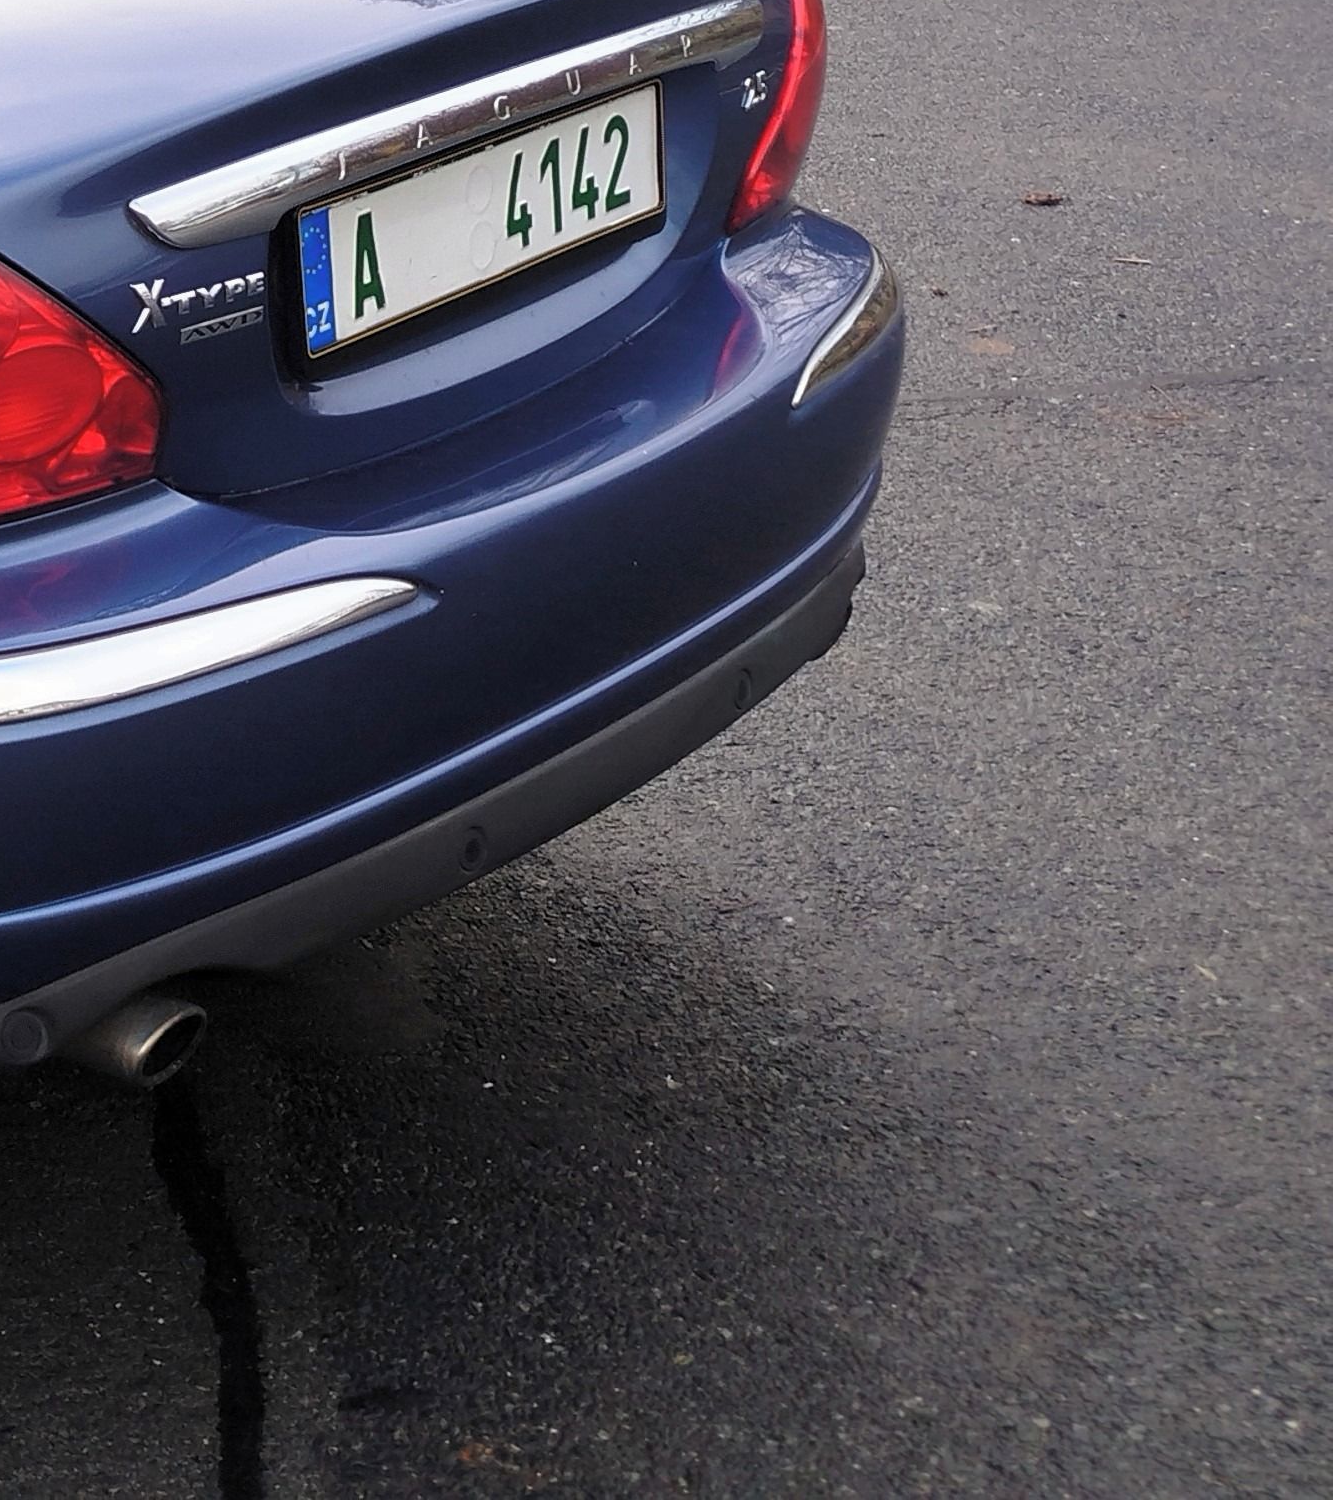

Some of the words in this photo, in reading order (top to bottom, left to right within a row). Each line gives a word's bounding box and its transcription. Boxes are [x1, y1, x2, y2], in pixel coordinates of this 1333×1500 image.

[337, 34, 694, 181] JAGUAR
[354, 208, 386, 321] A
[505, 113, 631, 249] 4142
[130, 271, 265, 334] X-TYPE
[183, 309, 264, 342] AWD
[307, 301, 332, 338] CZ
